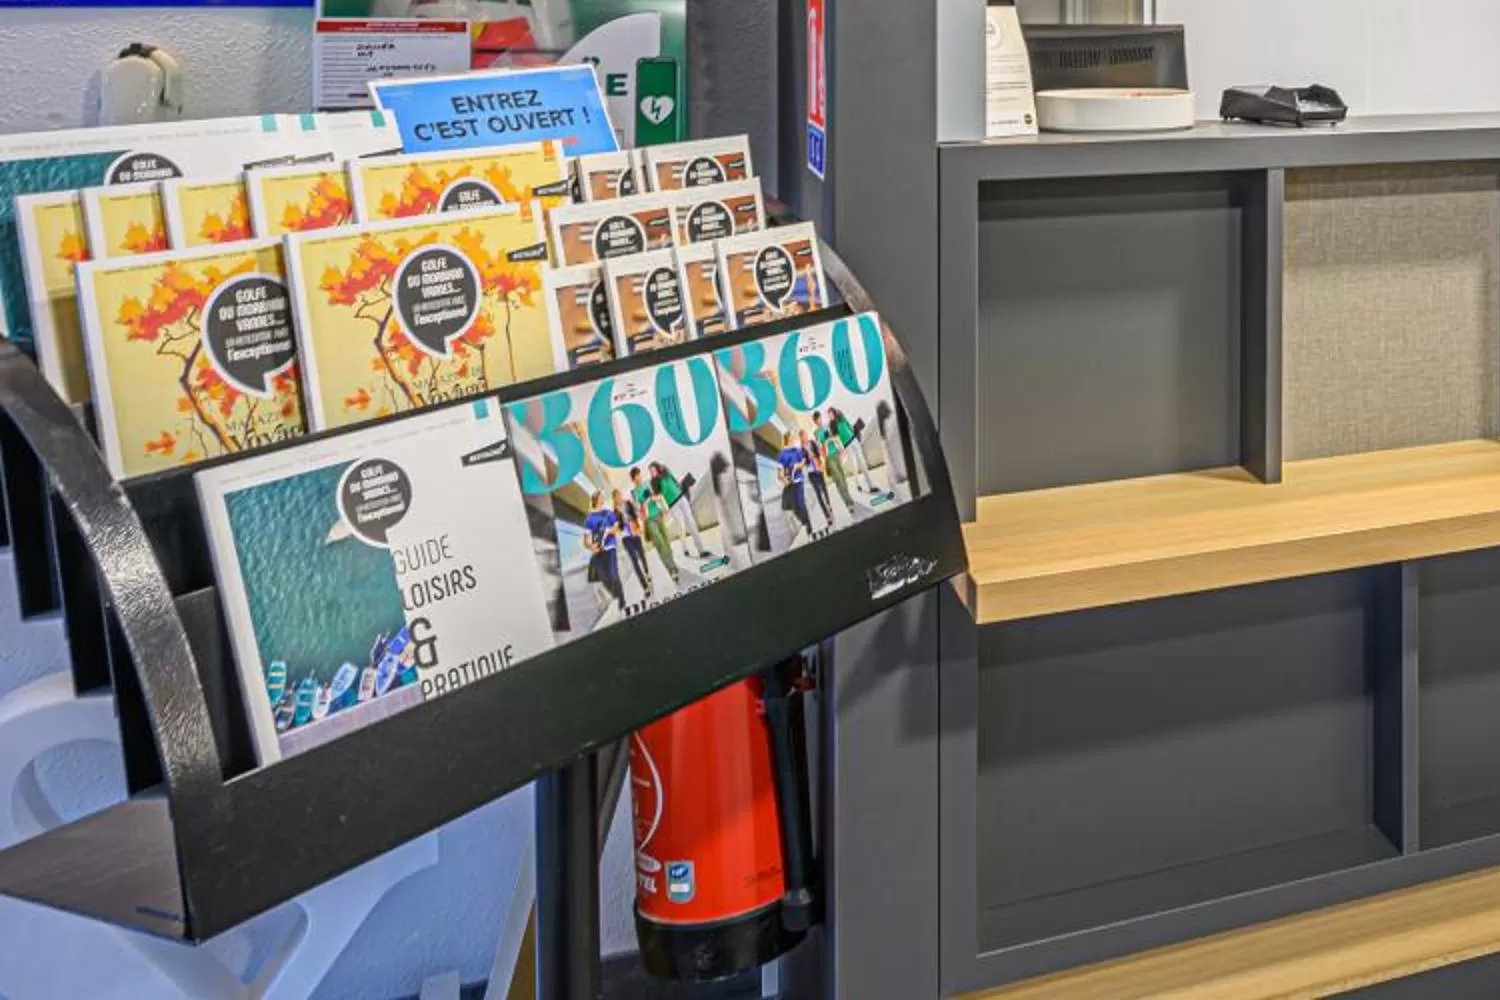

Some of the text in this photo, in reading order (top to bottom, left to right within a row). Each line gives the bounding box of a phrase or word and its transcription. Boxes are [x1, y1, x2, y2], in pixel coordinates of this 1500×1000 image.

[451, 90, 543, 115] ENTREZ
[413, 107, 591, 141] C'EST OUVERT !
[422, 257, 447, 272] GOLFE
[235, 286, 267, 303] GOLFE
[713, 313, 883, 432] 360
[507, 357, 718, 494] 360
[394, 534, 454, 575] GUIDE
[402, 565, 477, 610] LOISIRS
